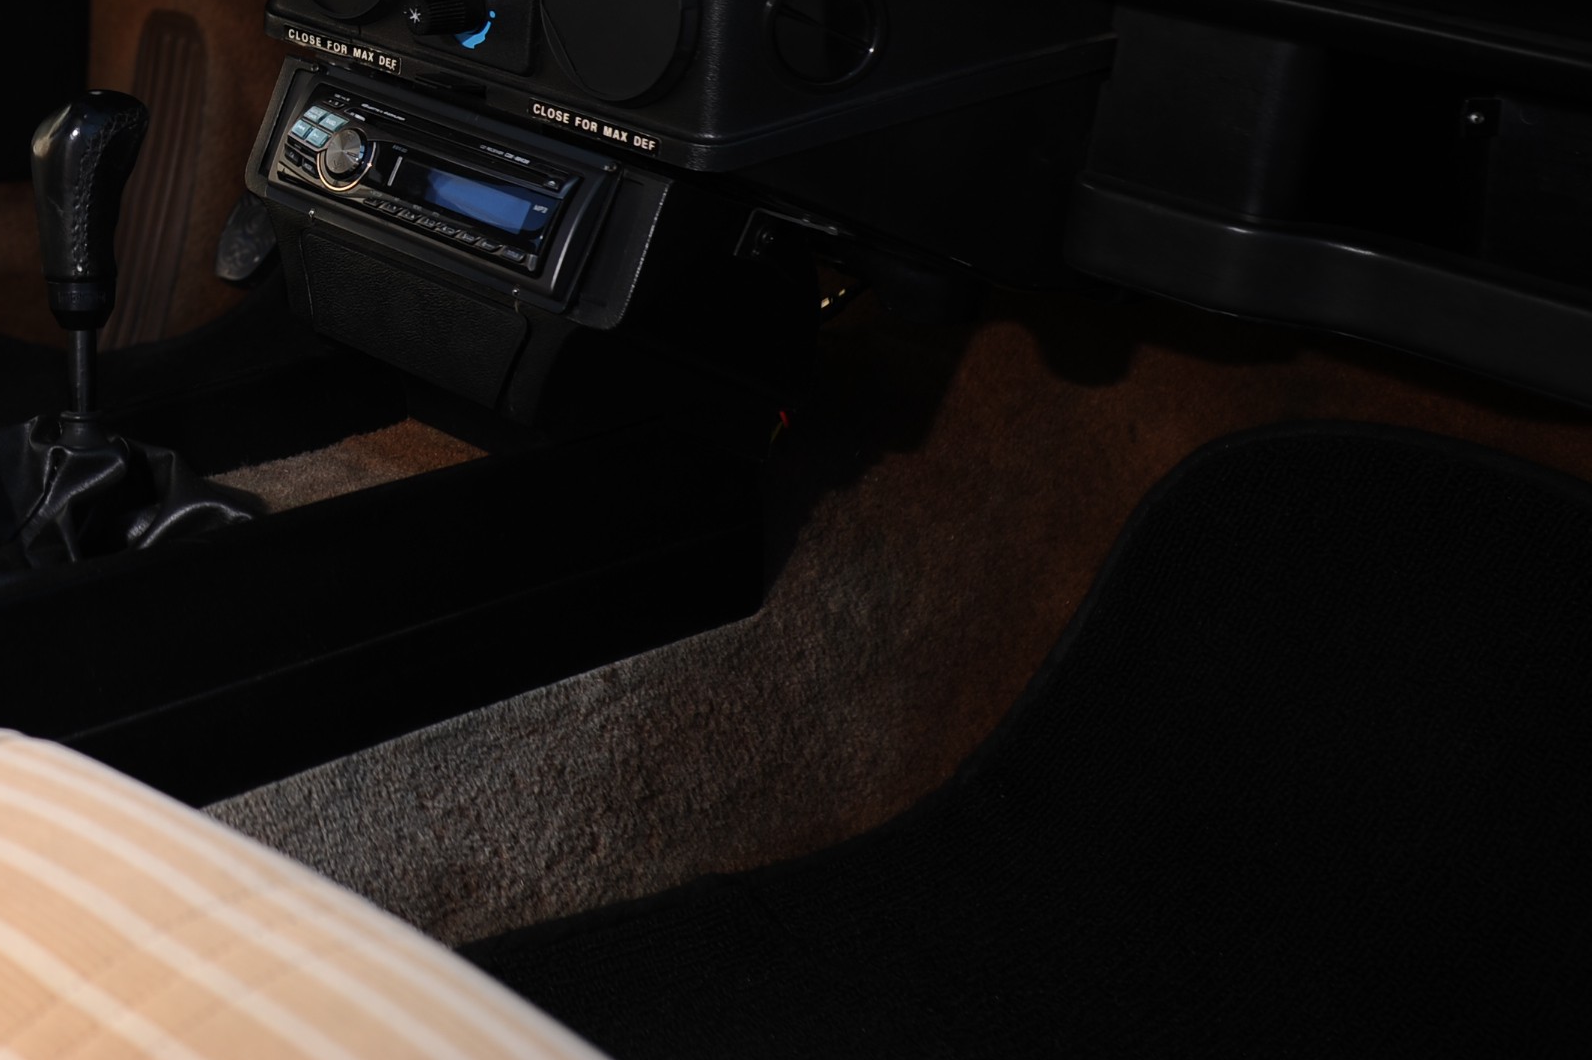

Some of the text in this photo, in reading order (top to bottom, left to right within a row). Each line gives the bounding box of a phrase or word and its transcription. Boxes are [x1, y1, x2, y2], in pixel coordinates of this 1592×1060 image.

[288, 28, 398, 71] CLOSE FOR MAX DEF
[532, 103, 657, 151] CLOSE FOR MAX DEF
